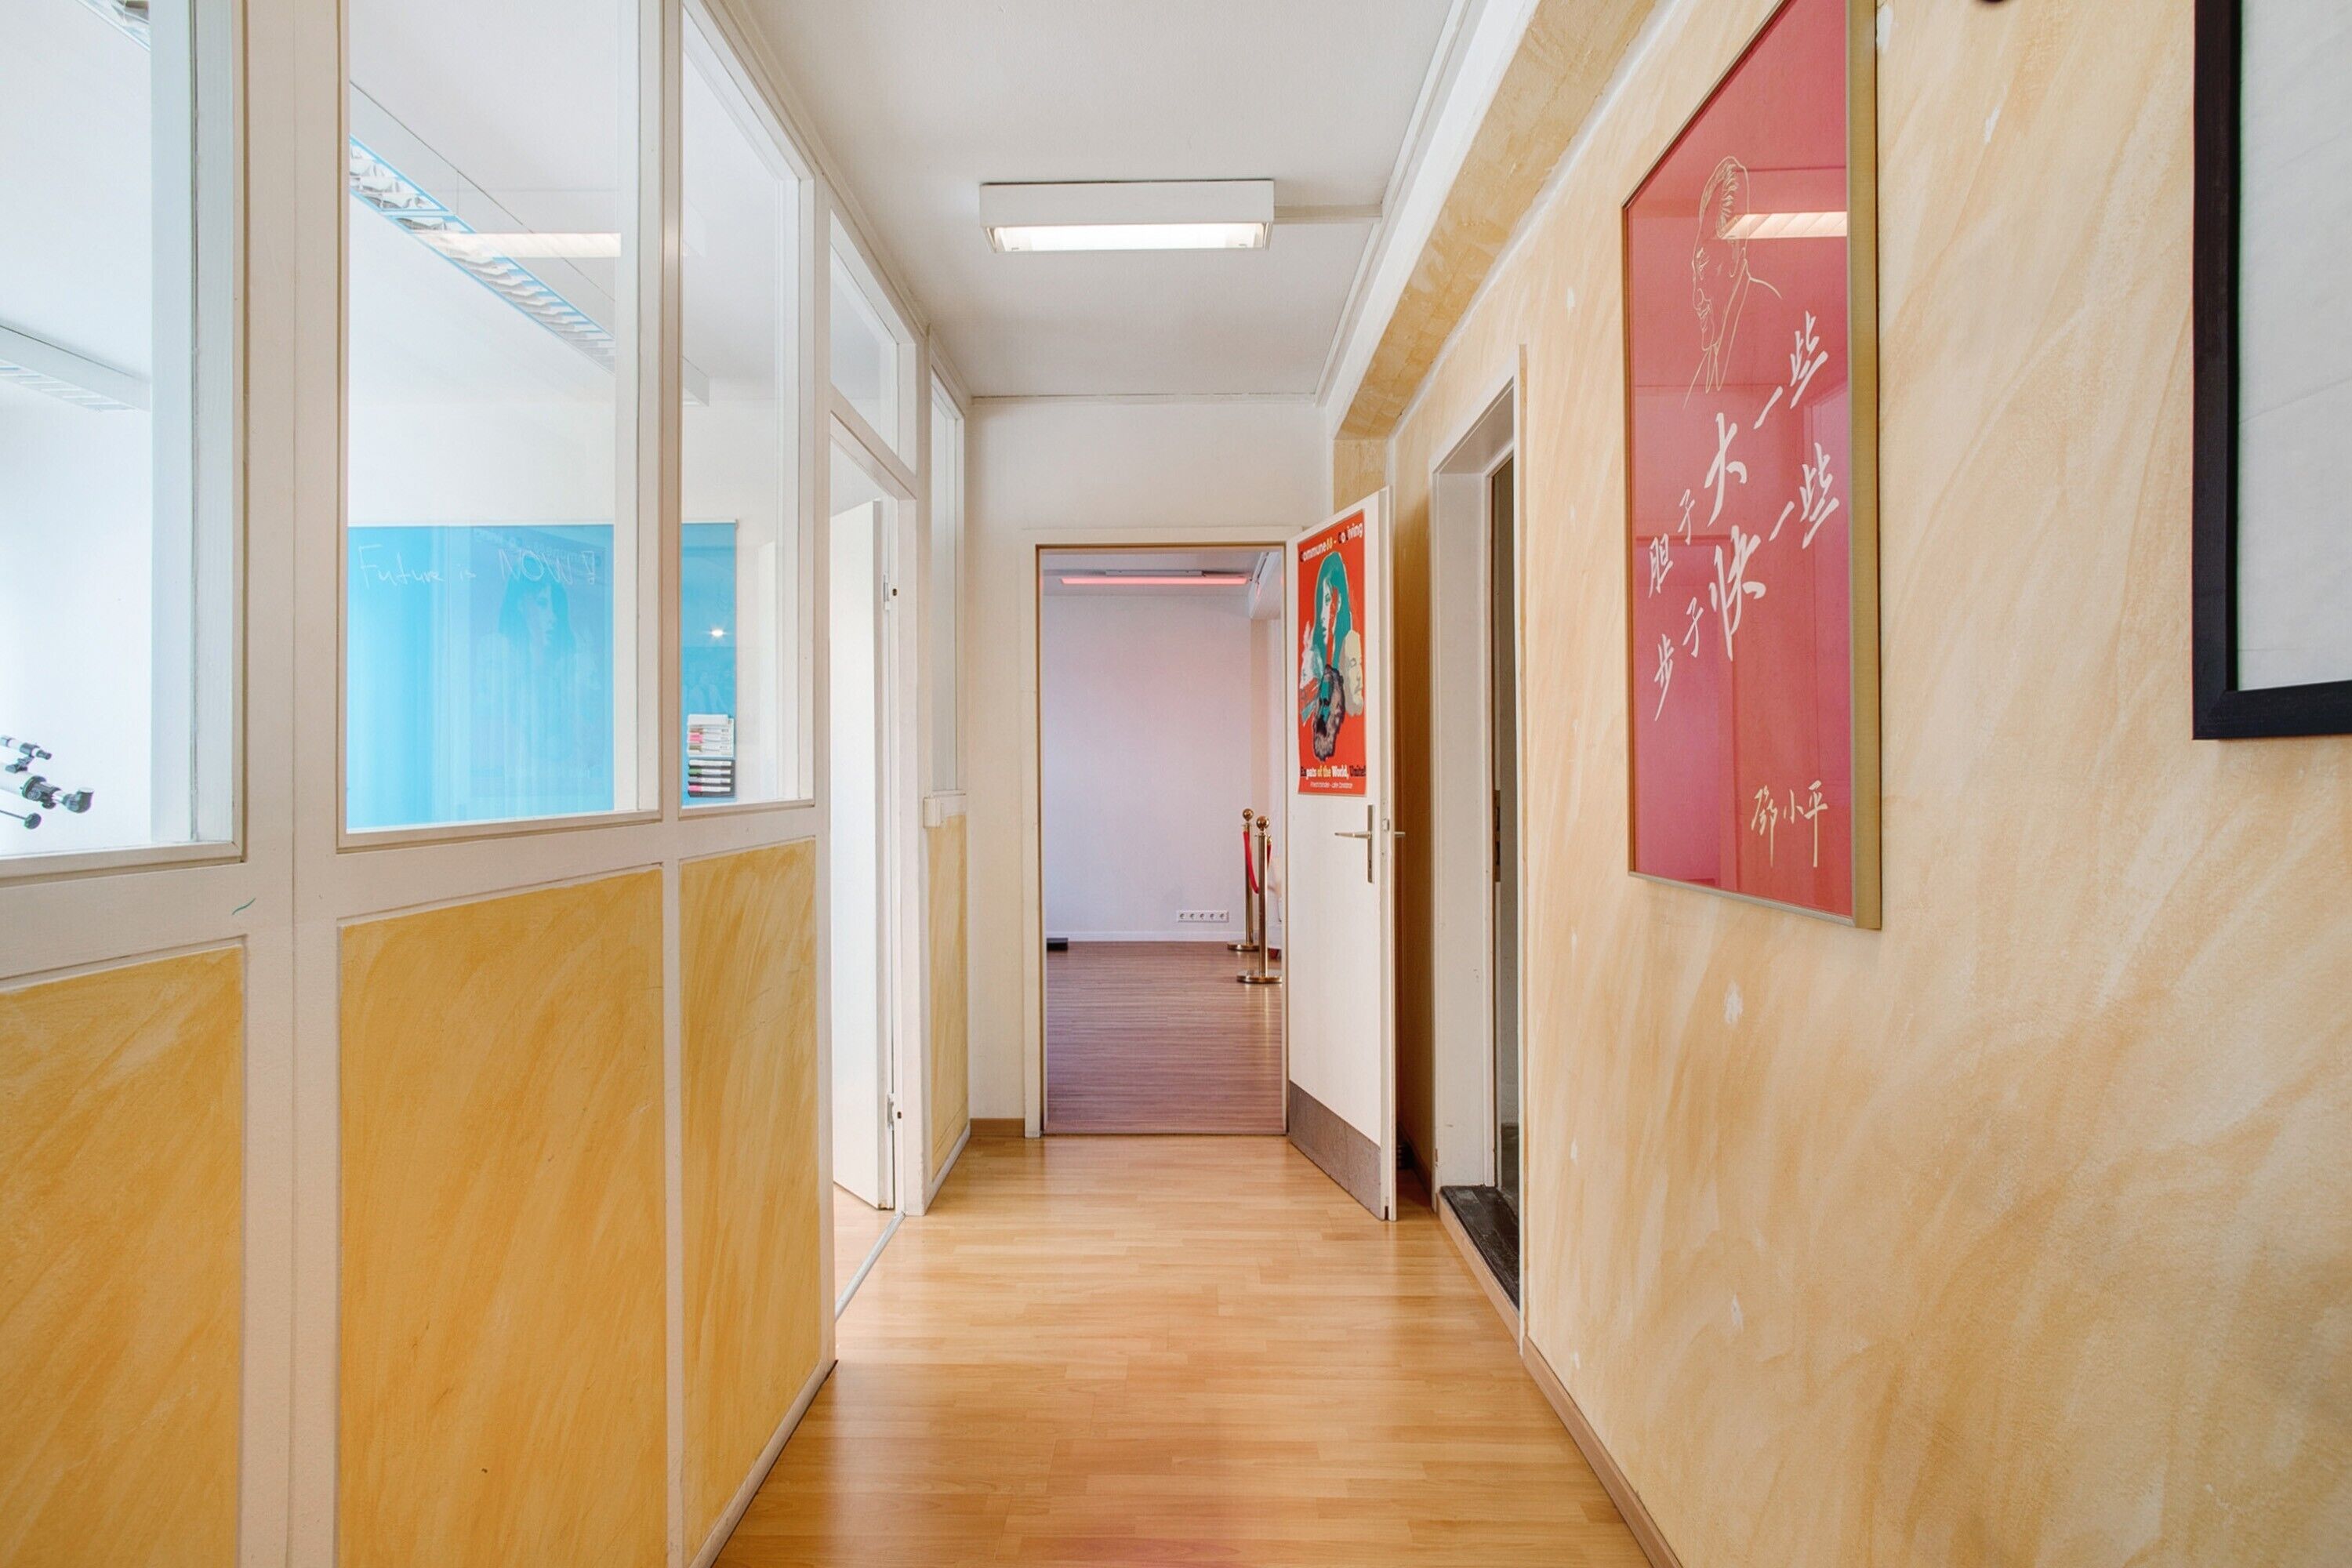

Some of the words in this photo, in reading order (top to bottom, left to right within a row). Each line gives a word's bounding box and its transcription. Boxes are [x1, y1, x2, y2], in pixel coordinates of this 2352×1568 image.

[358, 544, 445, 589] Future
[457, 564, 477, 580] is
[1317, 764, 1323, 778] of
[1323, 765, 1332, 778] the
